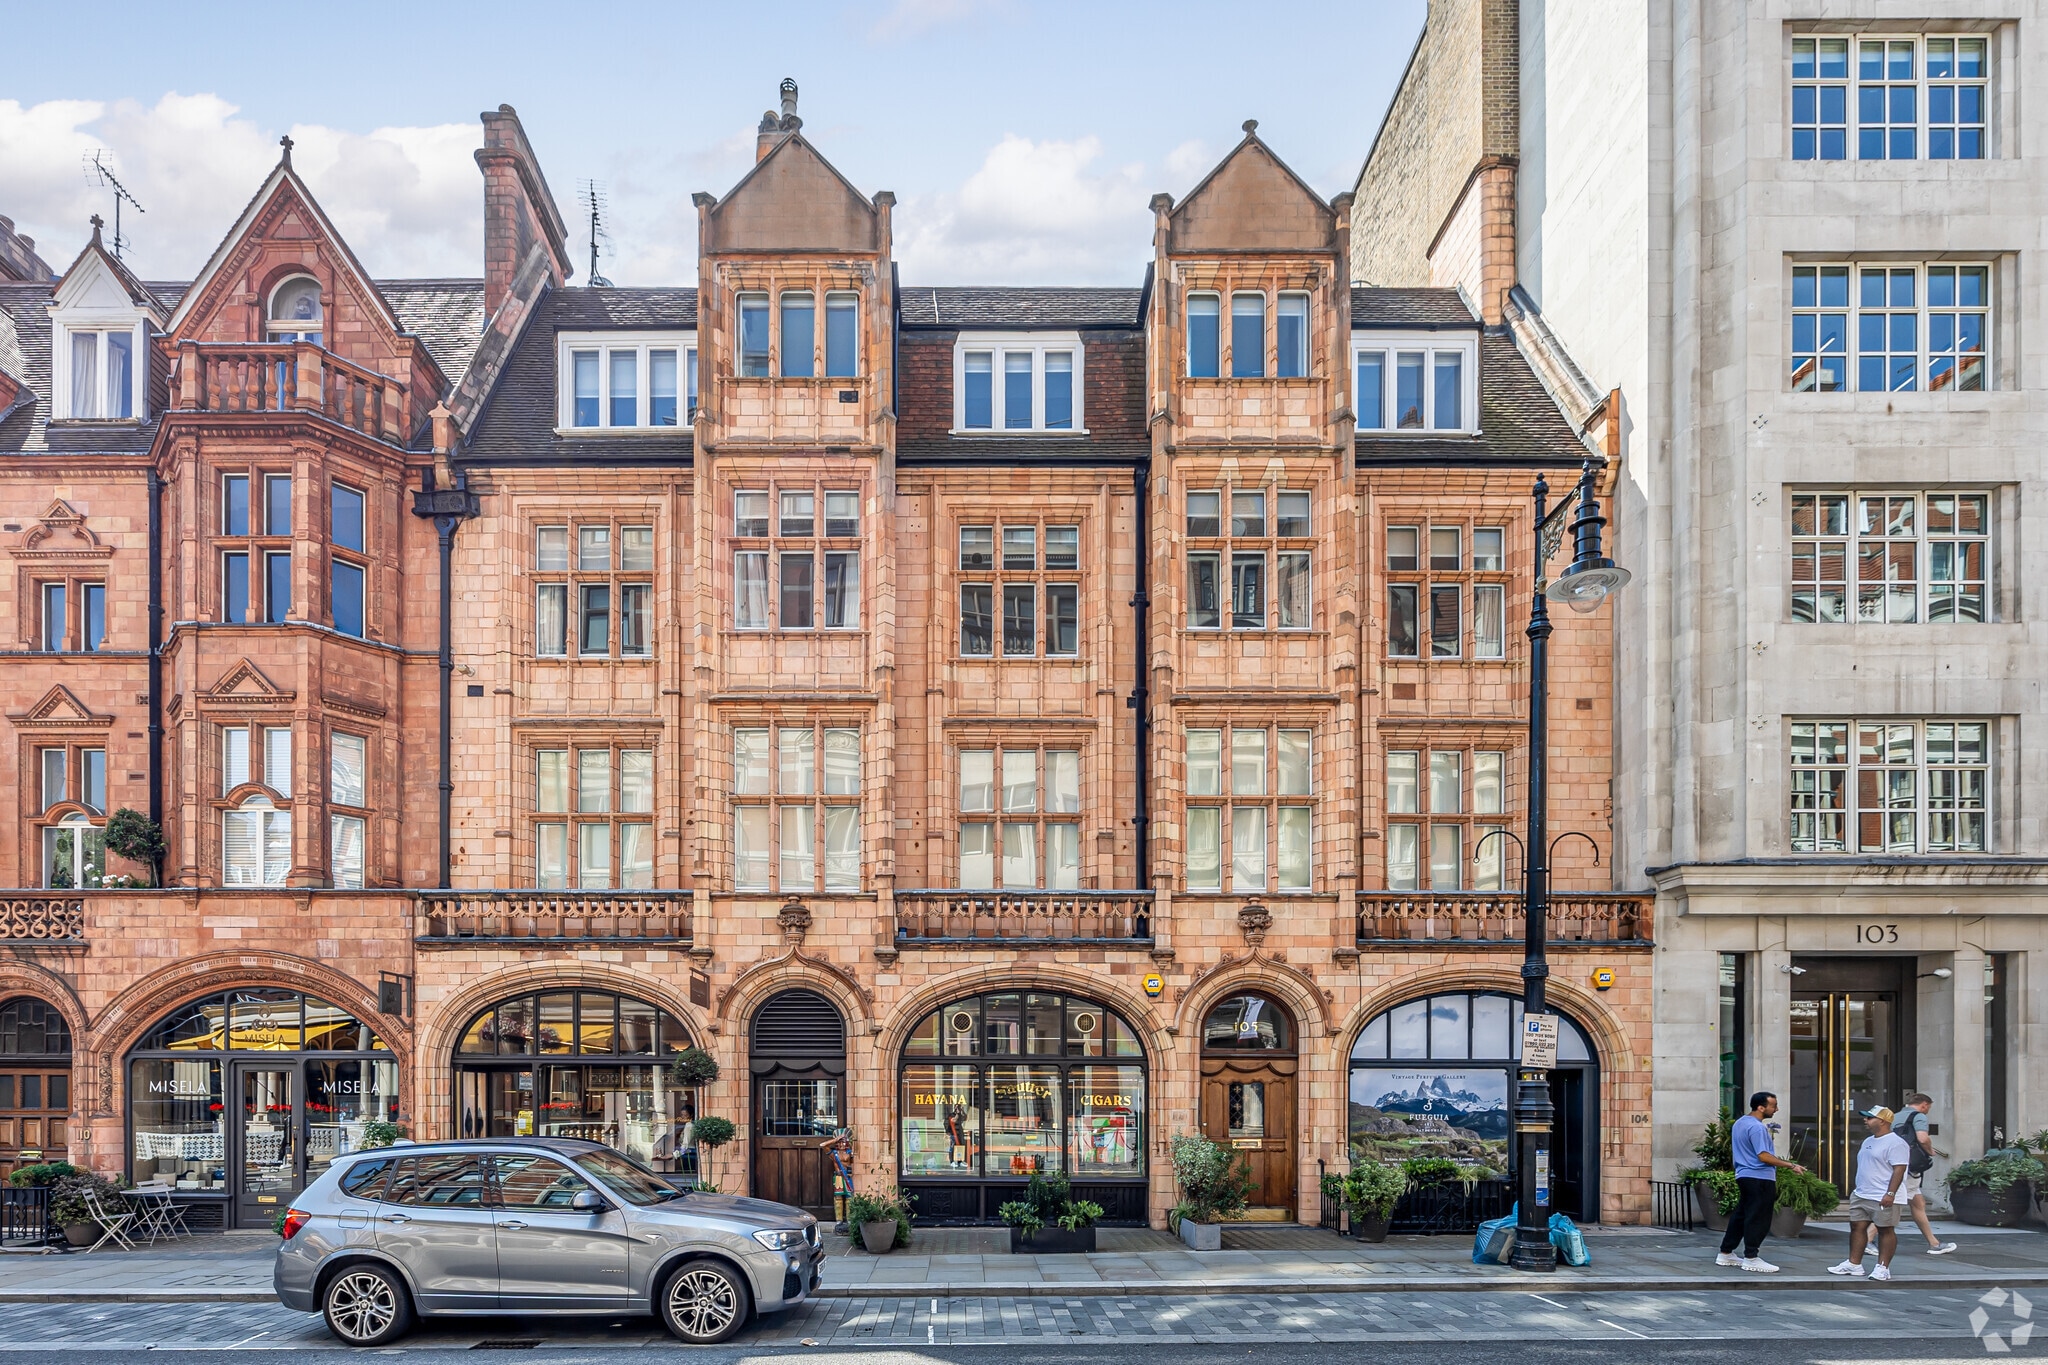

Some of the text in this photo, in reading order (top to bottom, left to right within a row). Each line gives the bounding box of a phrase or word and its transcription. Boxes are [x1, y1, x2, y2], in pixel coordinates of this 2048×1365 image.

[1856, 924, 1898, 943] 103
[1599, 973, 1611, 981] ADT
[1147, 979, 1159, 987] ADT
[1234, 1021, 1258, 1032] 105
[244, 1034, 286, 1043] MISELA
[149, 1080, 208, 1094] MISELA
[323, 1081, 381, 1094] MISELA
[914, 1093, 967, 1105] HAVANA
[1080, 1094, 1132, 1106] CIGARS
[1409, 1113, 1450, 1121] FUEGUIA
[1631, 1114, 1649, 1124] 104
